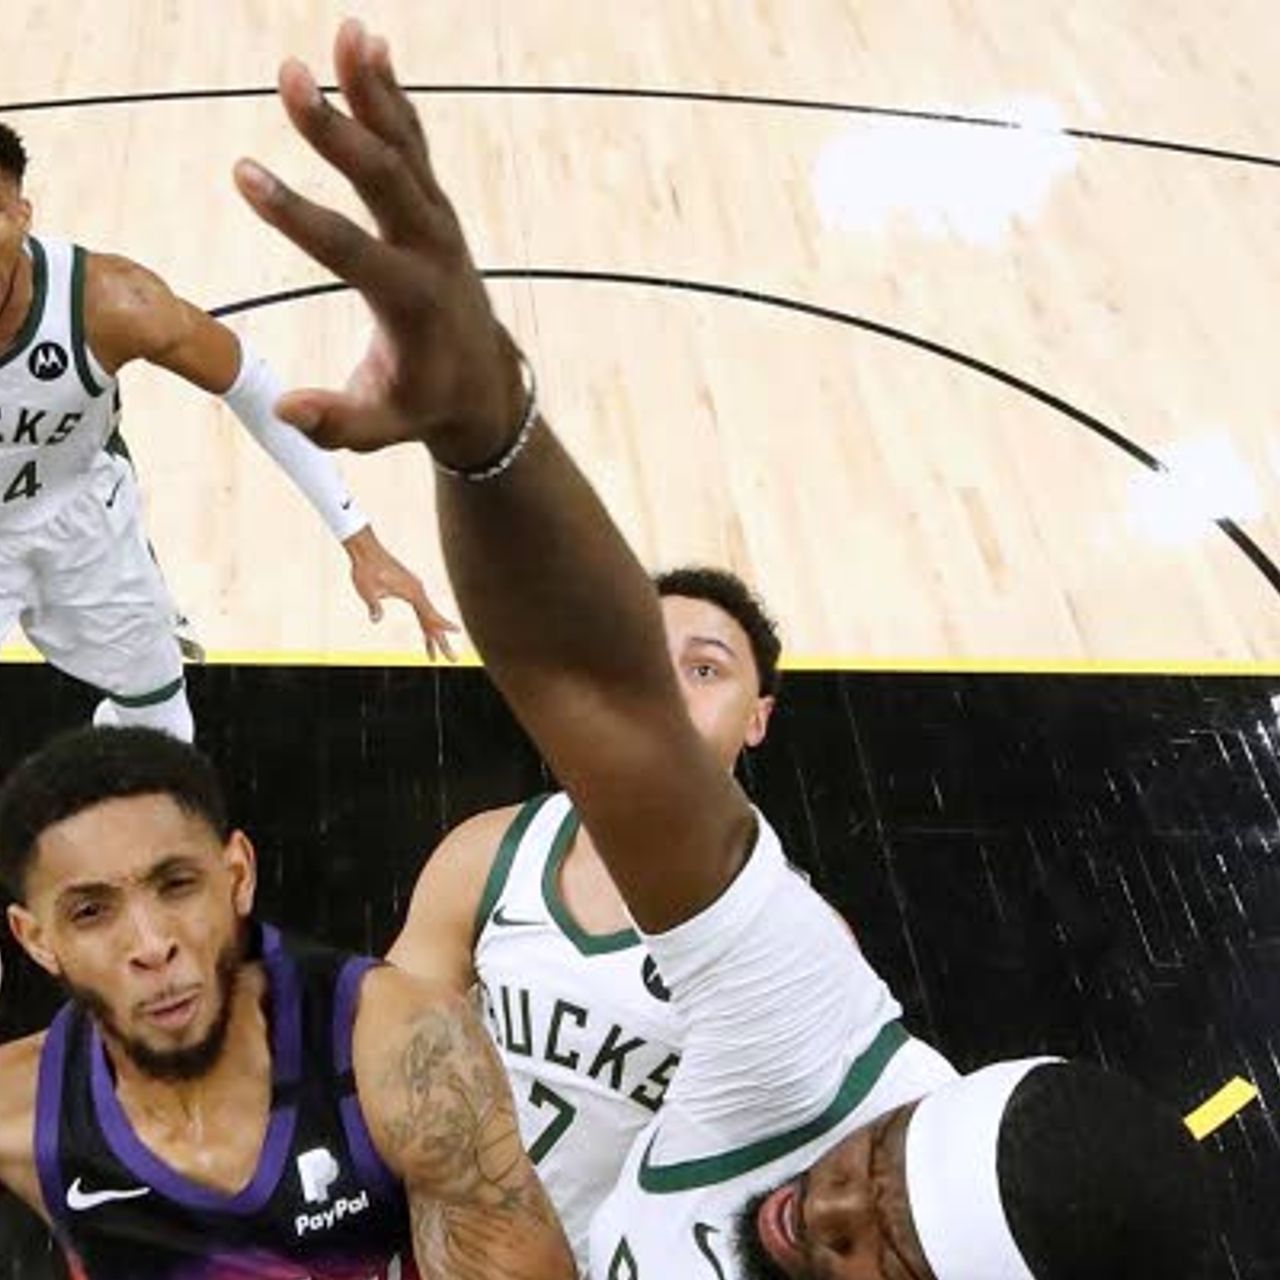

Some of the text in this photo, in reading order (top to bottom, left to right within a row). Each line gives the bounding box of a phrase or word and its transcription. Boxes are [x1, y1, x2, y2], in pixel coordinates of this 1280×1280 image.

[486, 982, 682, 1113] UCKS
[528, 1078, 577, 1165] 7
[295, 1190, 369, 1236] PayPal
